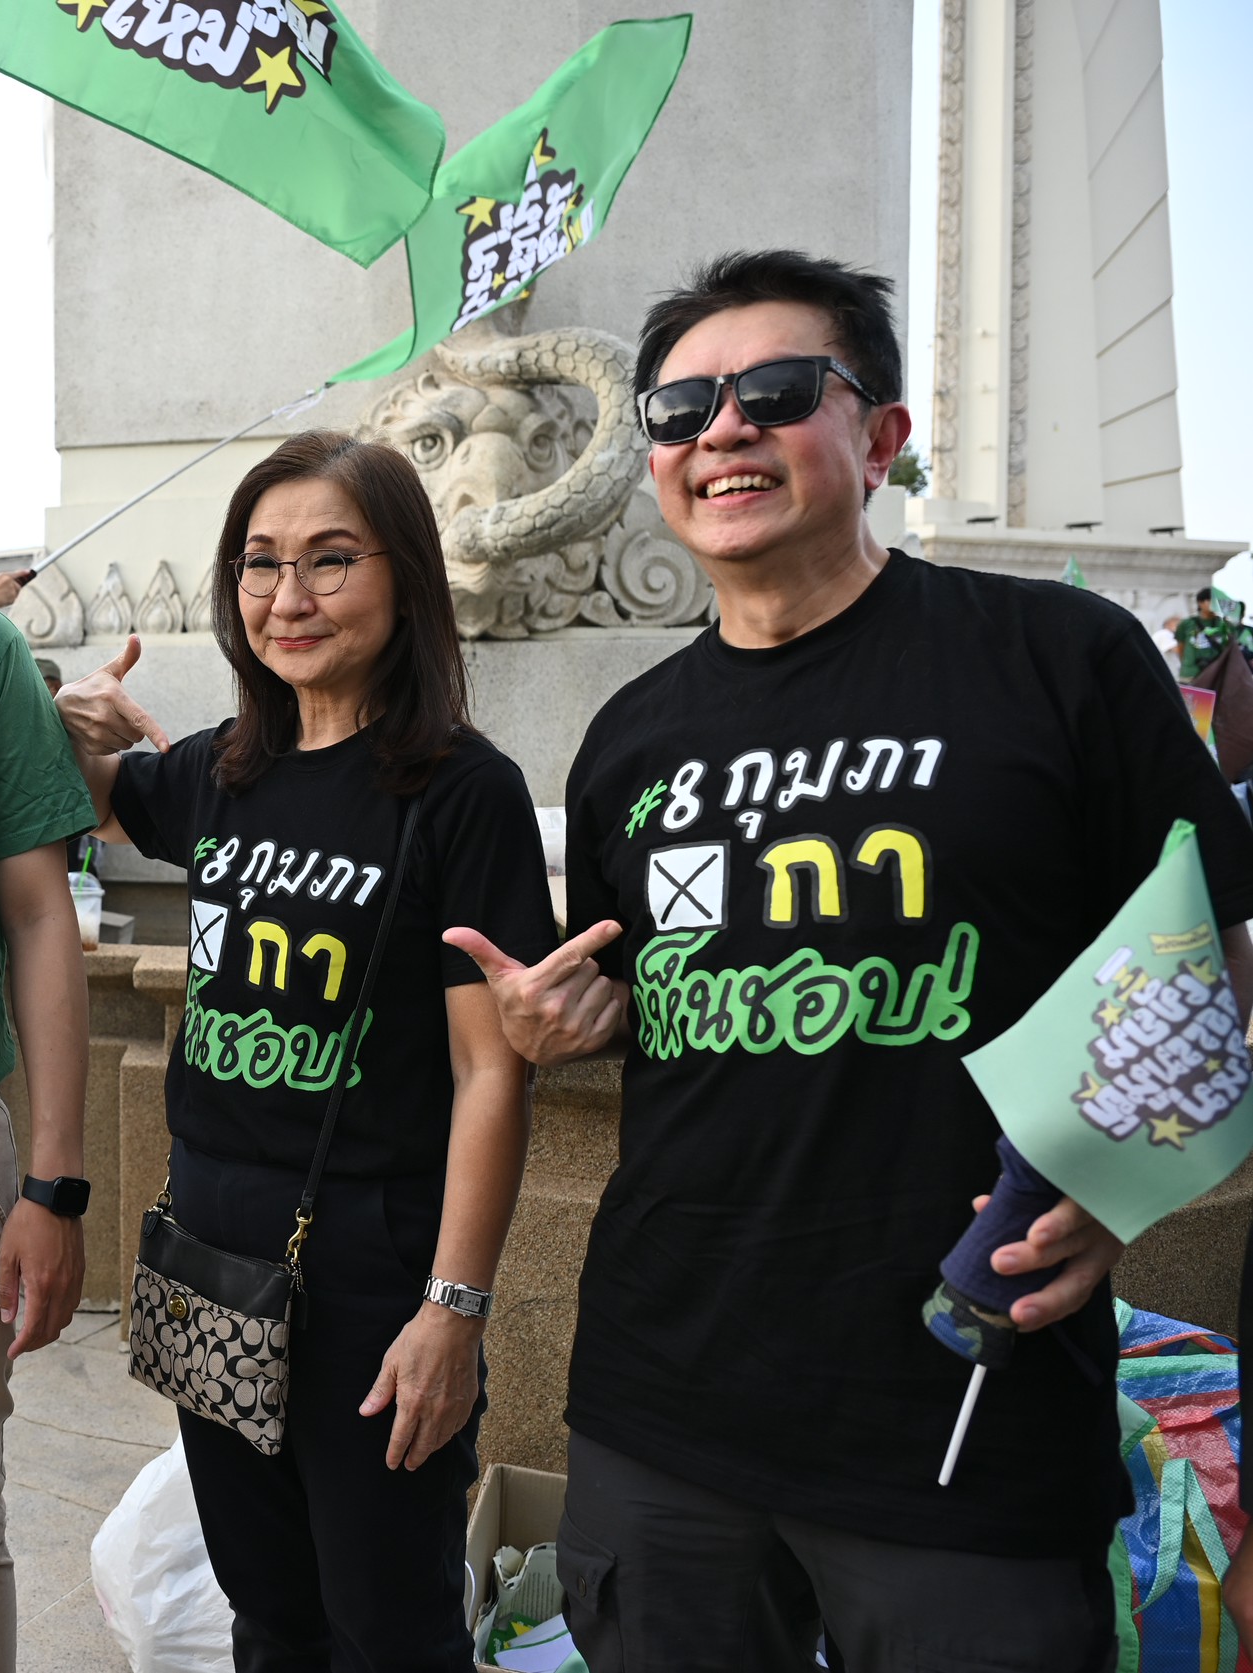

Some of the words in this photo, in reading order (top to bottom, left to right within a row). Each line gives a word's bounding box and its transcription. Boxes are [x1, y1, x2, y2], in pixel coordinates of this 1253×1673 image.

[625, 760, 705, 838] #8
[722, 738, 943, 840] กุมภา
[239, 841, 382, 911] กุมภา
[761, 828, 925, 922] กา
[247, 920, 348, 1001] กา
